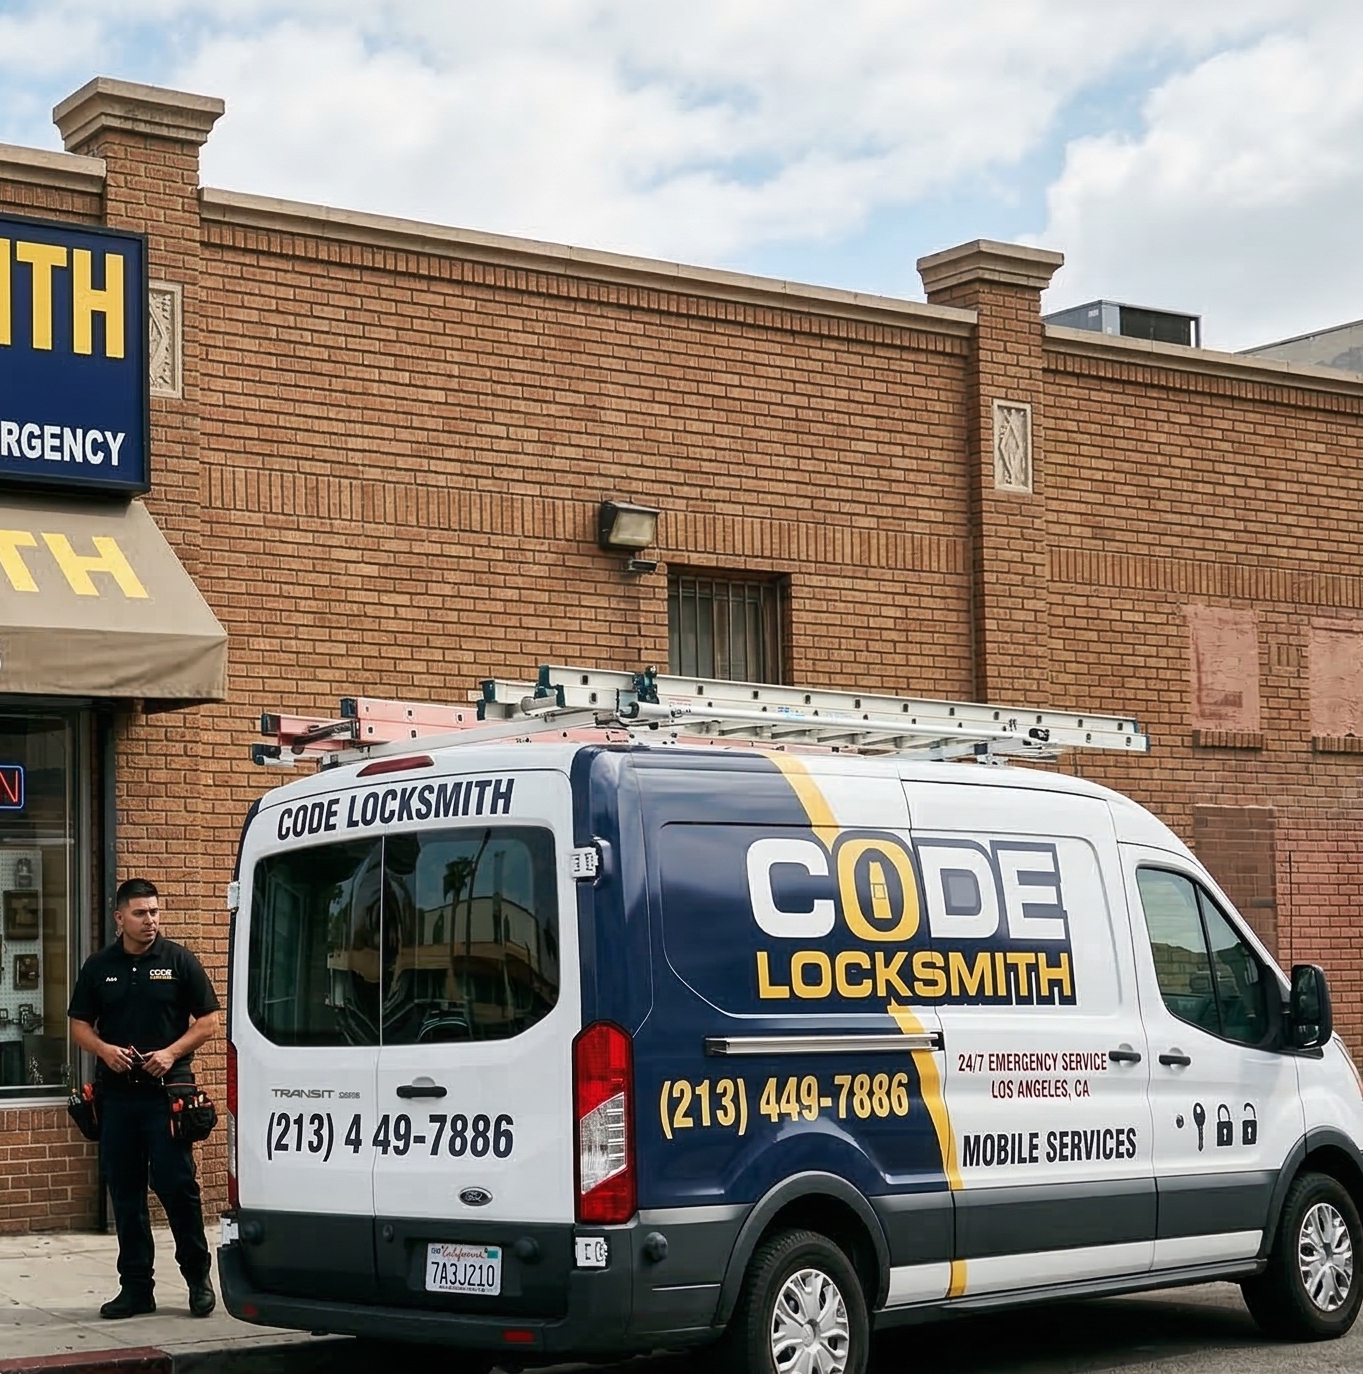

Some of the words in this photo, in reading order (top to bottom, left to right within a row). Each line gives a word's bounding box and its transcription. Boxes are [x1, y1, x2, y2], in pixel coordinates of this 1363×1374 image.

[277, 799, 338, 841] CODE
[347, 778, 515, 829] LOCKSMITH
[745, 838, 1068, 942] CODE
[756, 951, 1073, 999] LOCKSMITH
[958, 1054, 985, 1074] 24/7
[988, 1053, 1059, 1073] EMERGENCY
[1061, 1052, 1107, 1072] SERVICE
[271, 1088, 335, 1099] TRANSIT
[659, 1076, 748, 1140] (213)
[759, 1072, 909, 1125] 449-7886
[991, 1080, 1015, 1099] LOS
[1018, 1079, 1072, 1101] ANGELES,
[1074, 1078, 1090, 1098] CA
[266, 1111, 334, 1162] (213)
[962, 1133, 1039, 1167] MOBILE
[1045, 1128, 1136, 1163] SERVICES
[431, 1261, 495, 1288] 7A3J210
